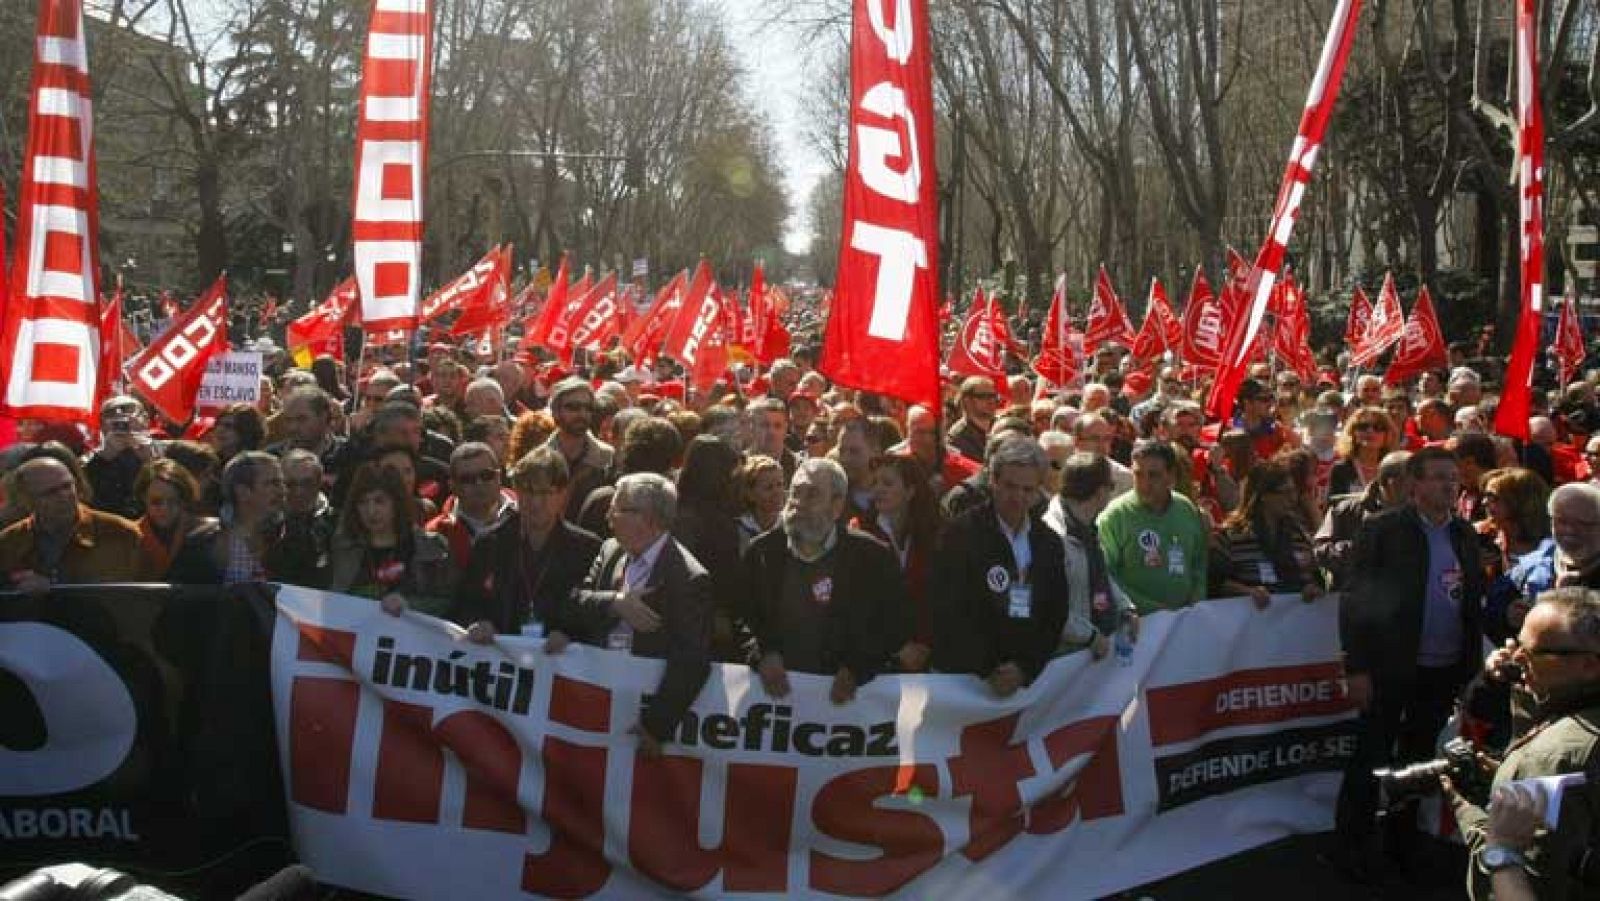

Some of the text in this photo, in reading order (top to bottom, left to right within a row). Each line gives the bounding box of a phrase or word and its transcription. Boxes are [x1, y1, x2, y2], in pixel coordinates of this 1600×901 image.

[372, 636, 899, 757] inútil neficaz
[1216, 680, 1331, 714] DEFIENDE
[290, 621, 1126, 900] injusta
[1168, 750, 1271, 794] DEFIENDE
